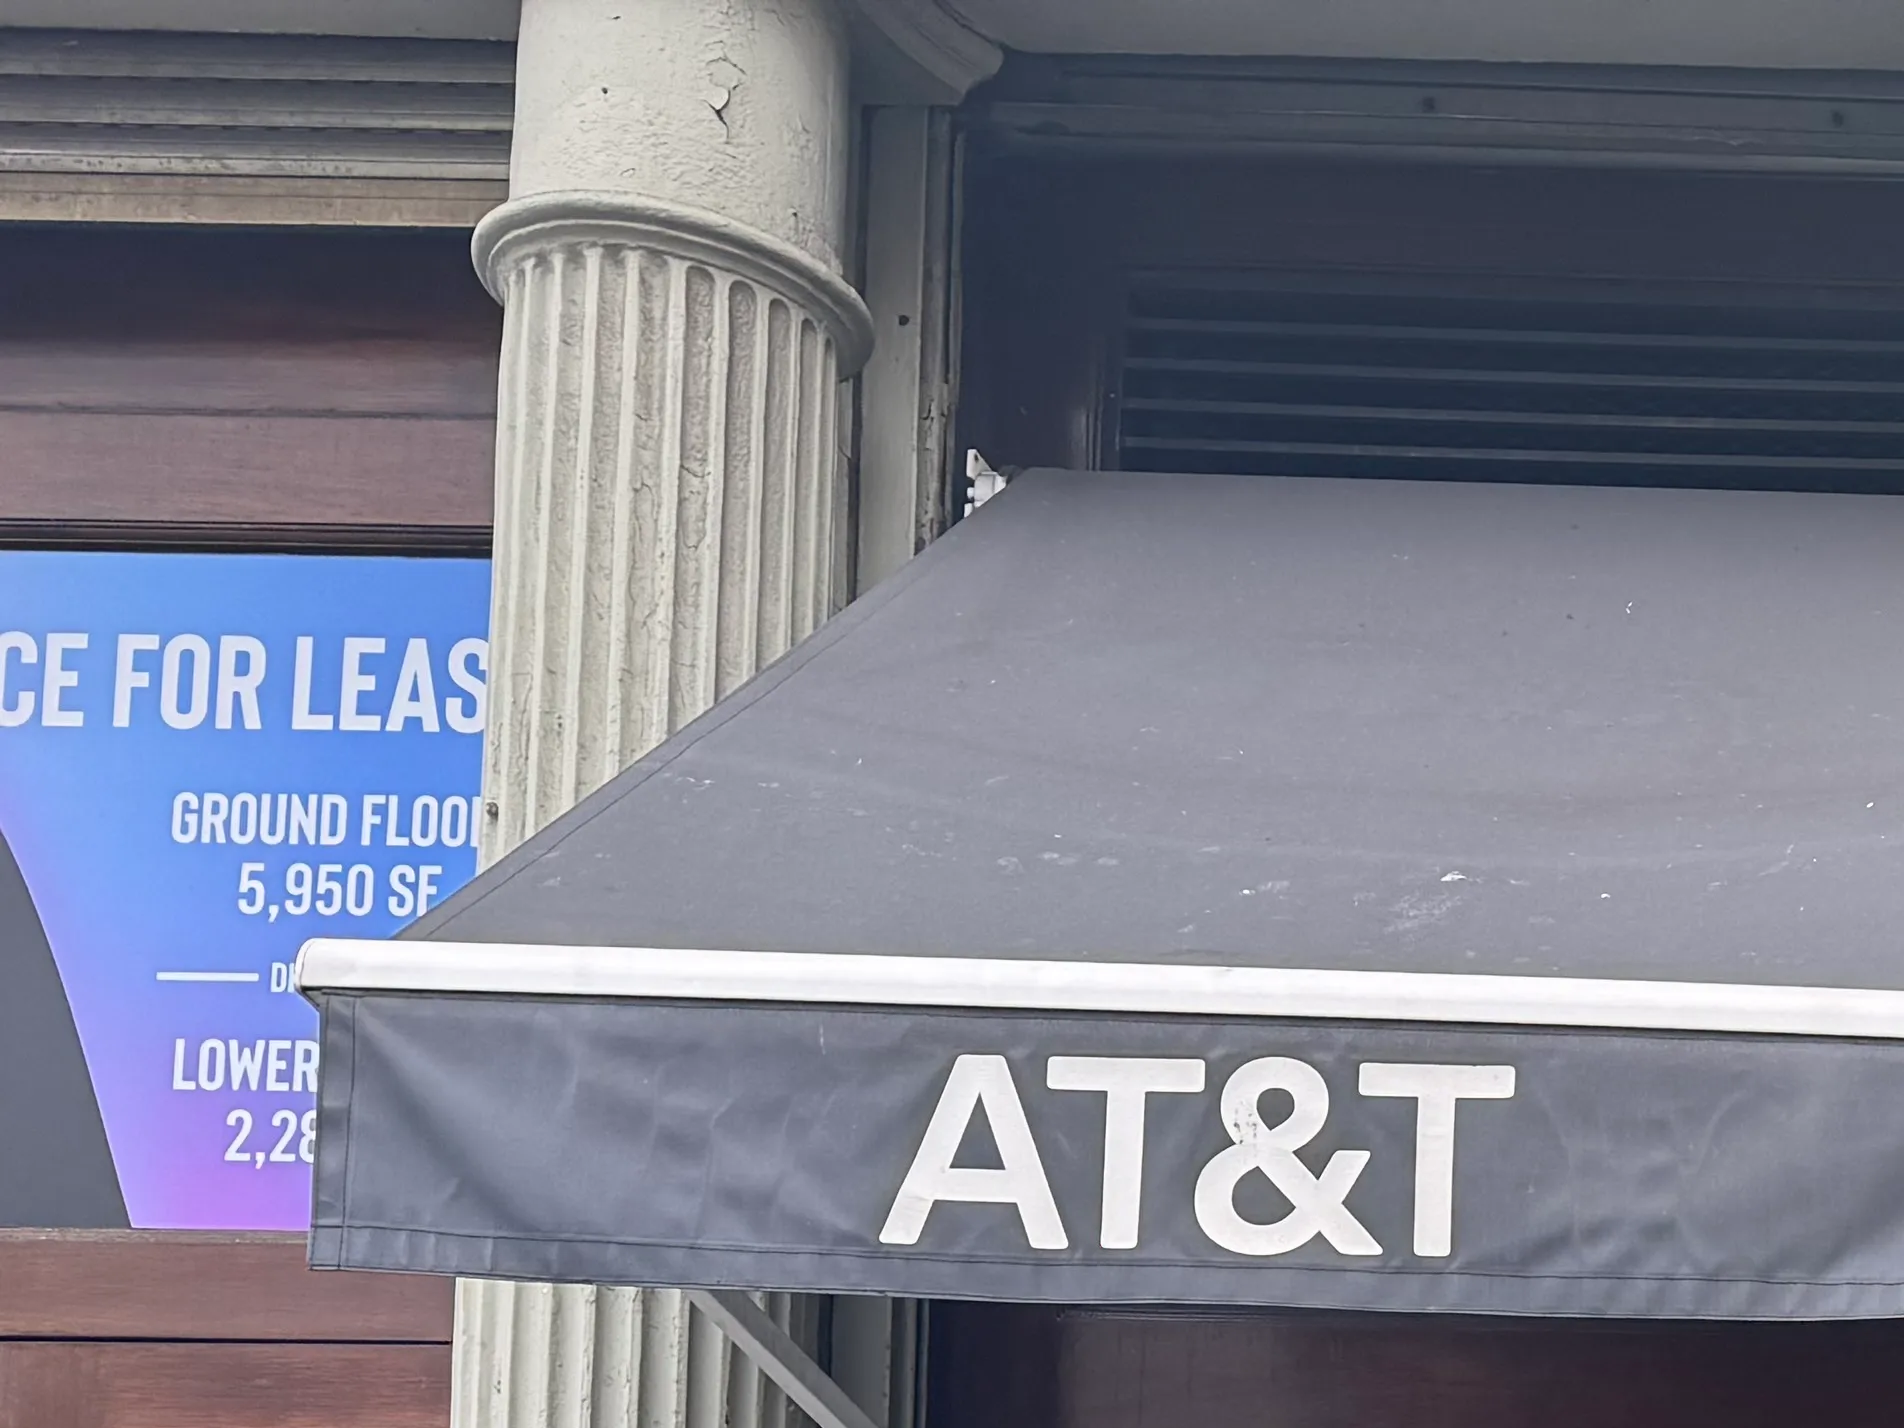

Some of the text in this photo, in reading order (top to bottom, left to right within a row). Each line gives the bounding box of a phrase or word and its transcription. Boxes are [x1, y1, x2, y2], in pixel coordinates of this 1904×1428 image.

[0, 631, 489, 734] CE FOR LEAS
[171, 791, 348, 845] GROUND
[237, 861, 443, 923] 5,950 SF
[173, 1038, 320, 1093] LOWER
[878, 1053, 1516, 1257] AT&T
